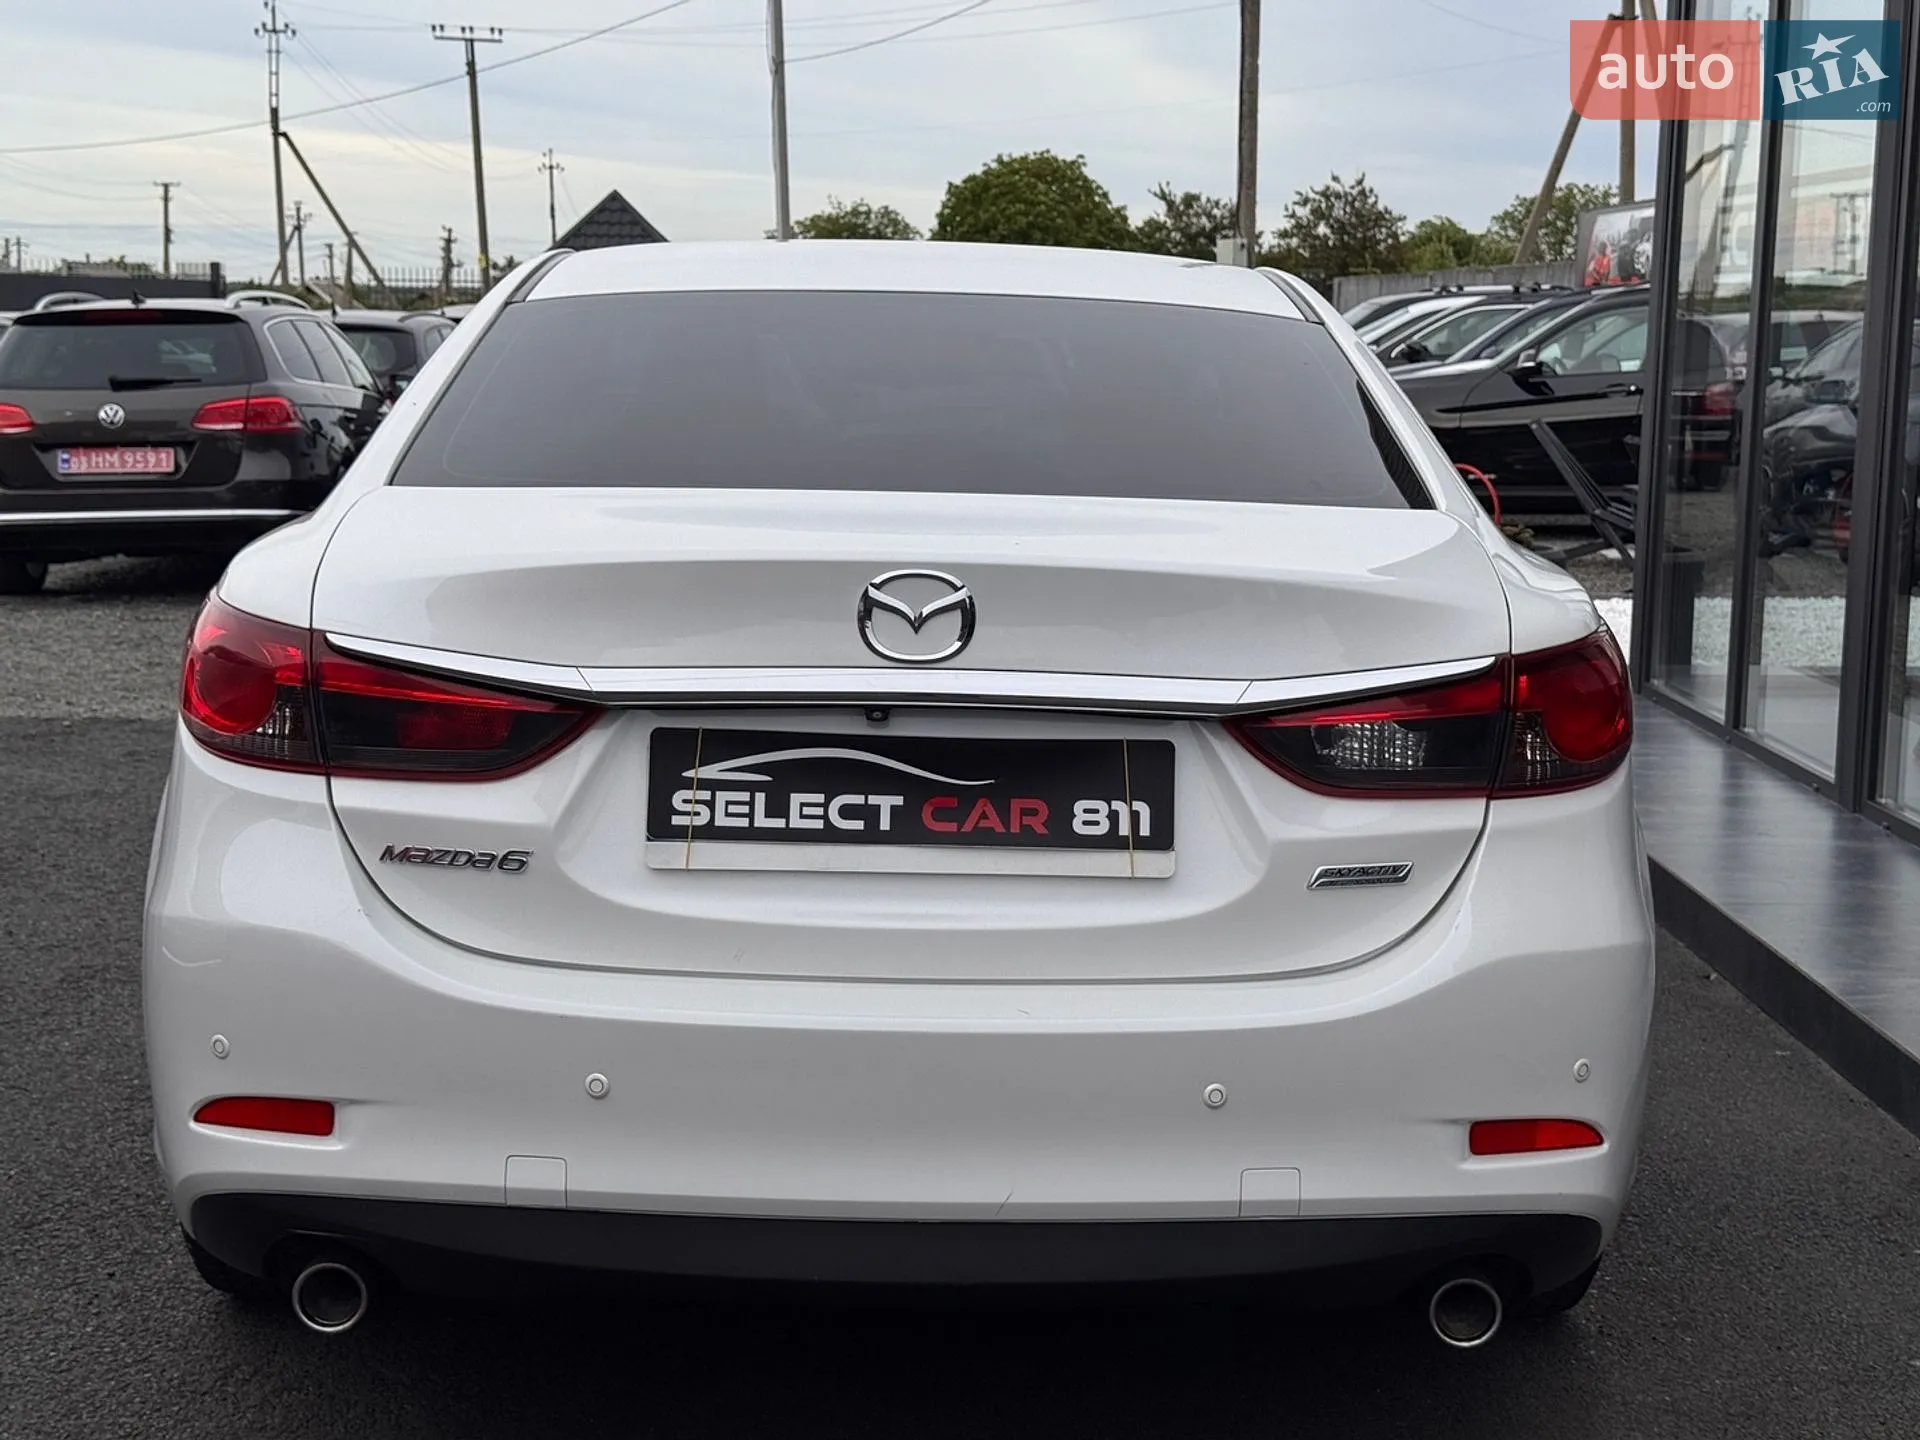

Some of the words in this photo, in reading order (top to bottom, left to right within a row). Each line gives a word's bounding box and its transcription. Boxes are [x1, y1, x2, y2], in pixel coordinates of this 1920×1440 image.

[123, 451, 169, 469] 9591
[670, 790, 904, 831] SELECT
[920, 796, 1050, 835] CAR
[1071, 799, 1152, 837] 811
